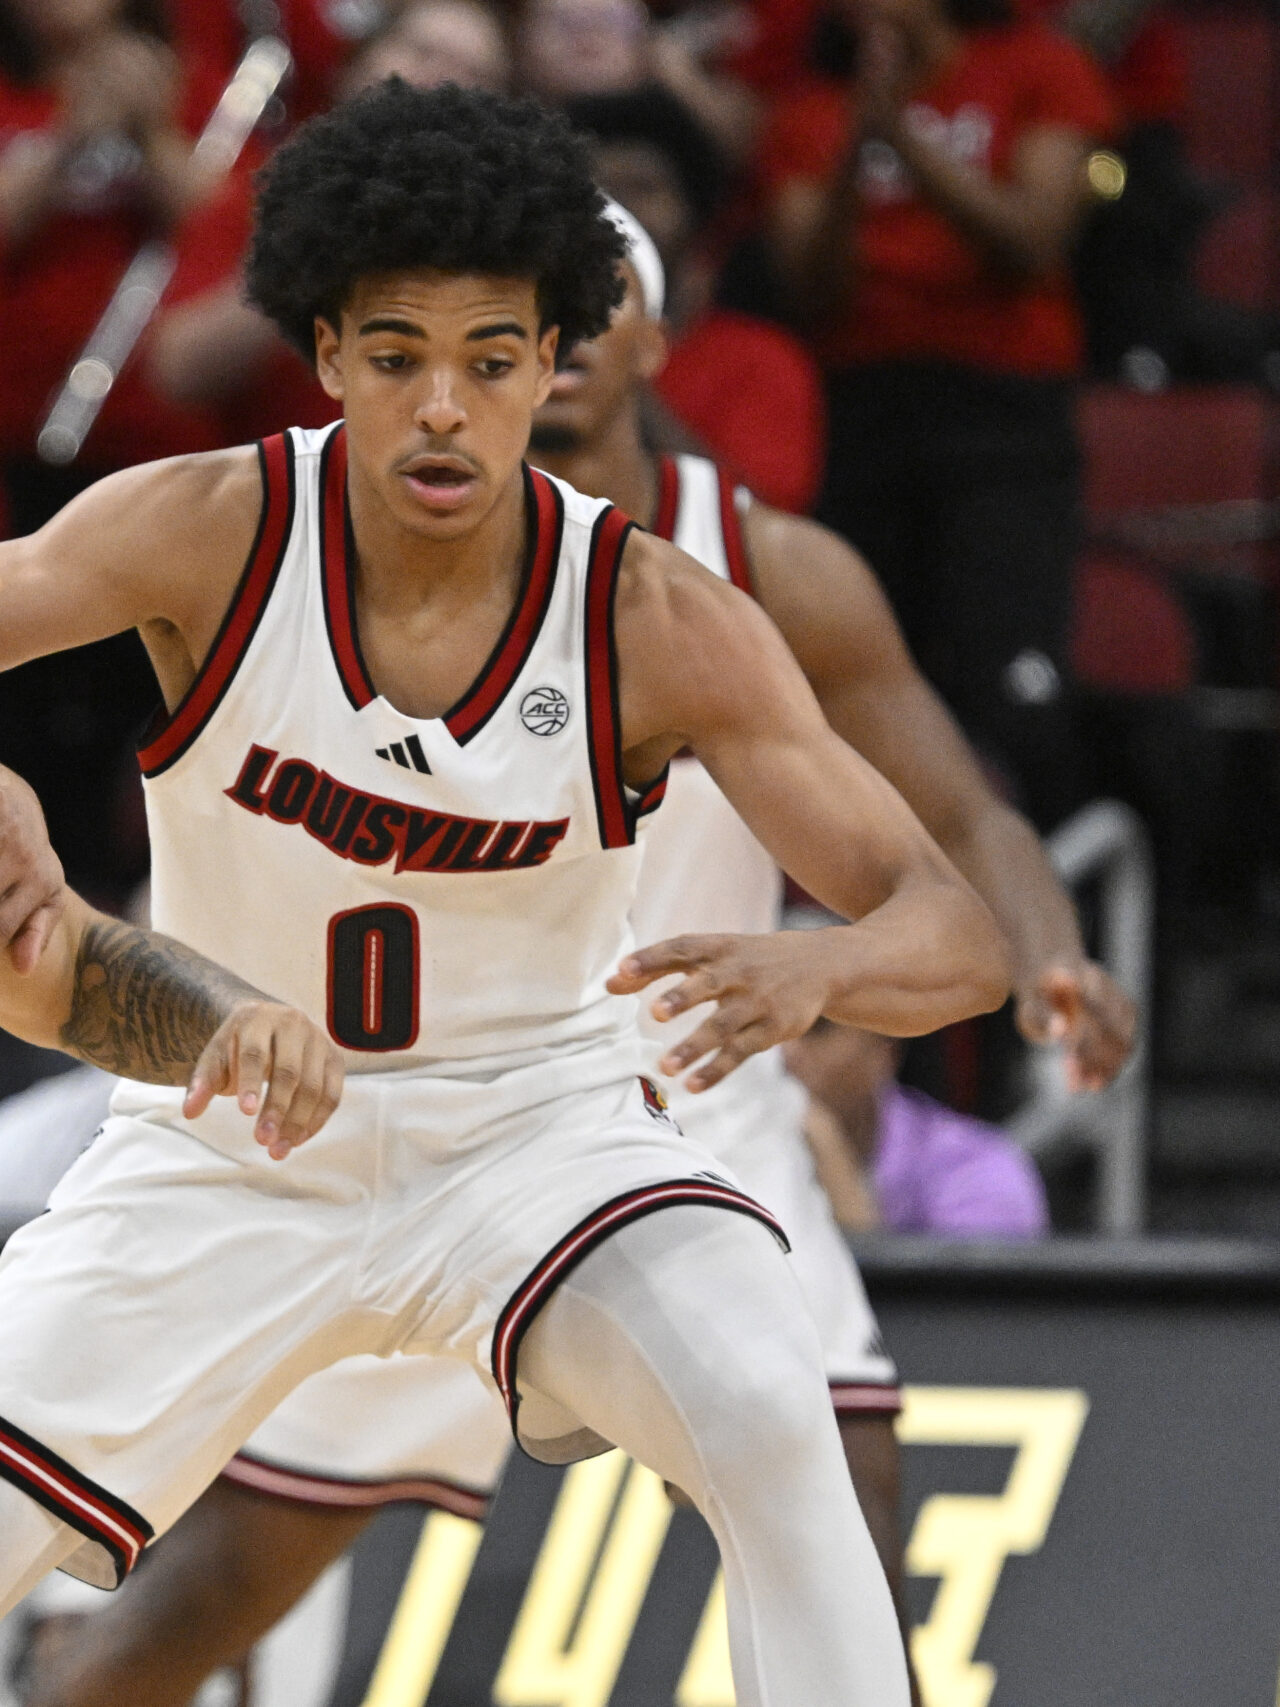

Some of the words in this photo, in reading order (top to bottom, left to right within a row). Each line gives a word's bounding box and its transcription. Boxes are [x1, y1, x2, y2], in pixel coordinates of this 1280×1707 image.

[526, 702, 567, 714] ACC
[223, 743, 570, 875] LOUISVILLE
[326, 901, 420, 1053] 0
